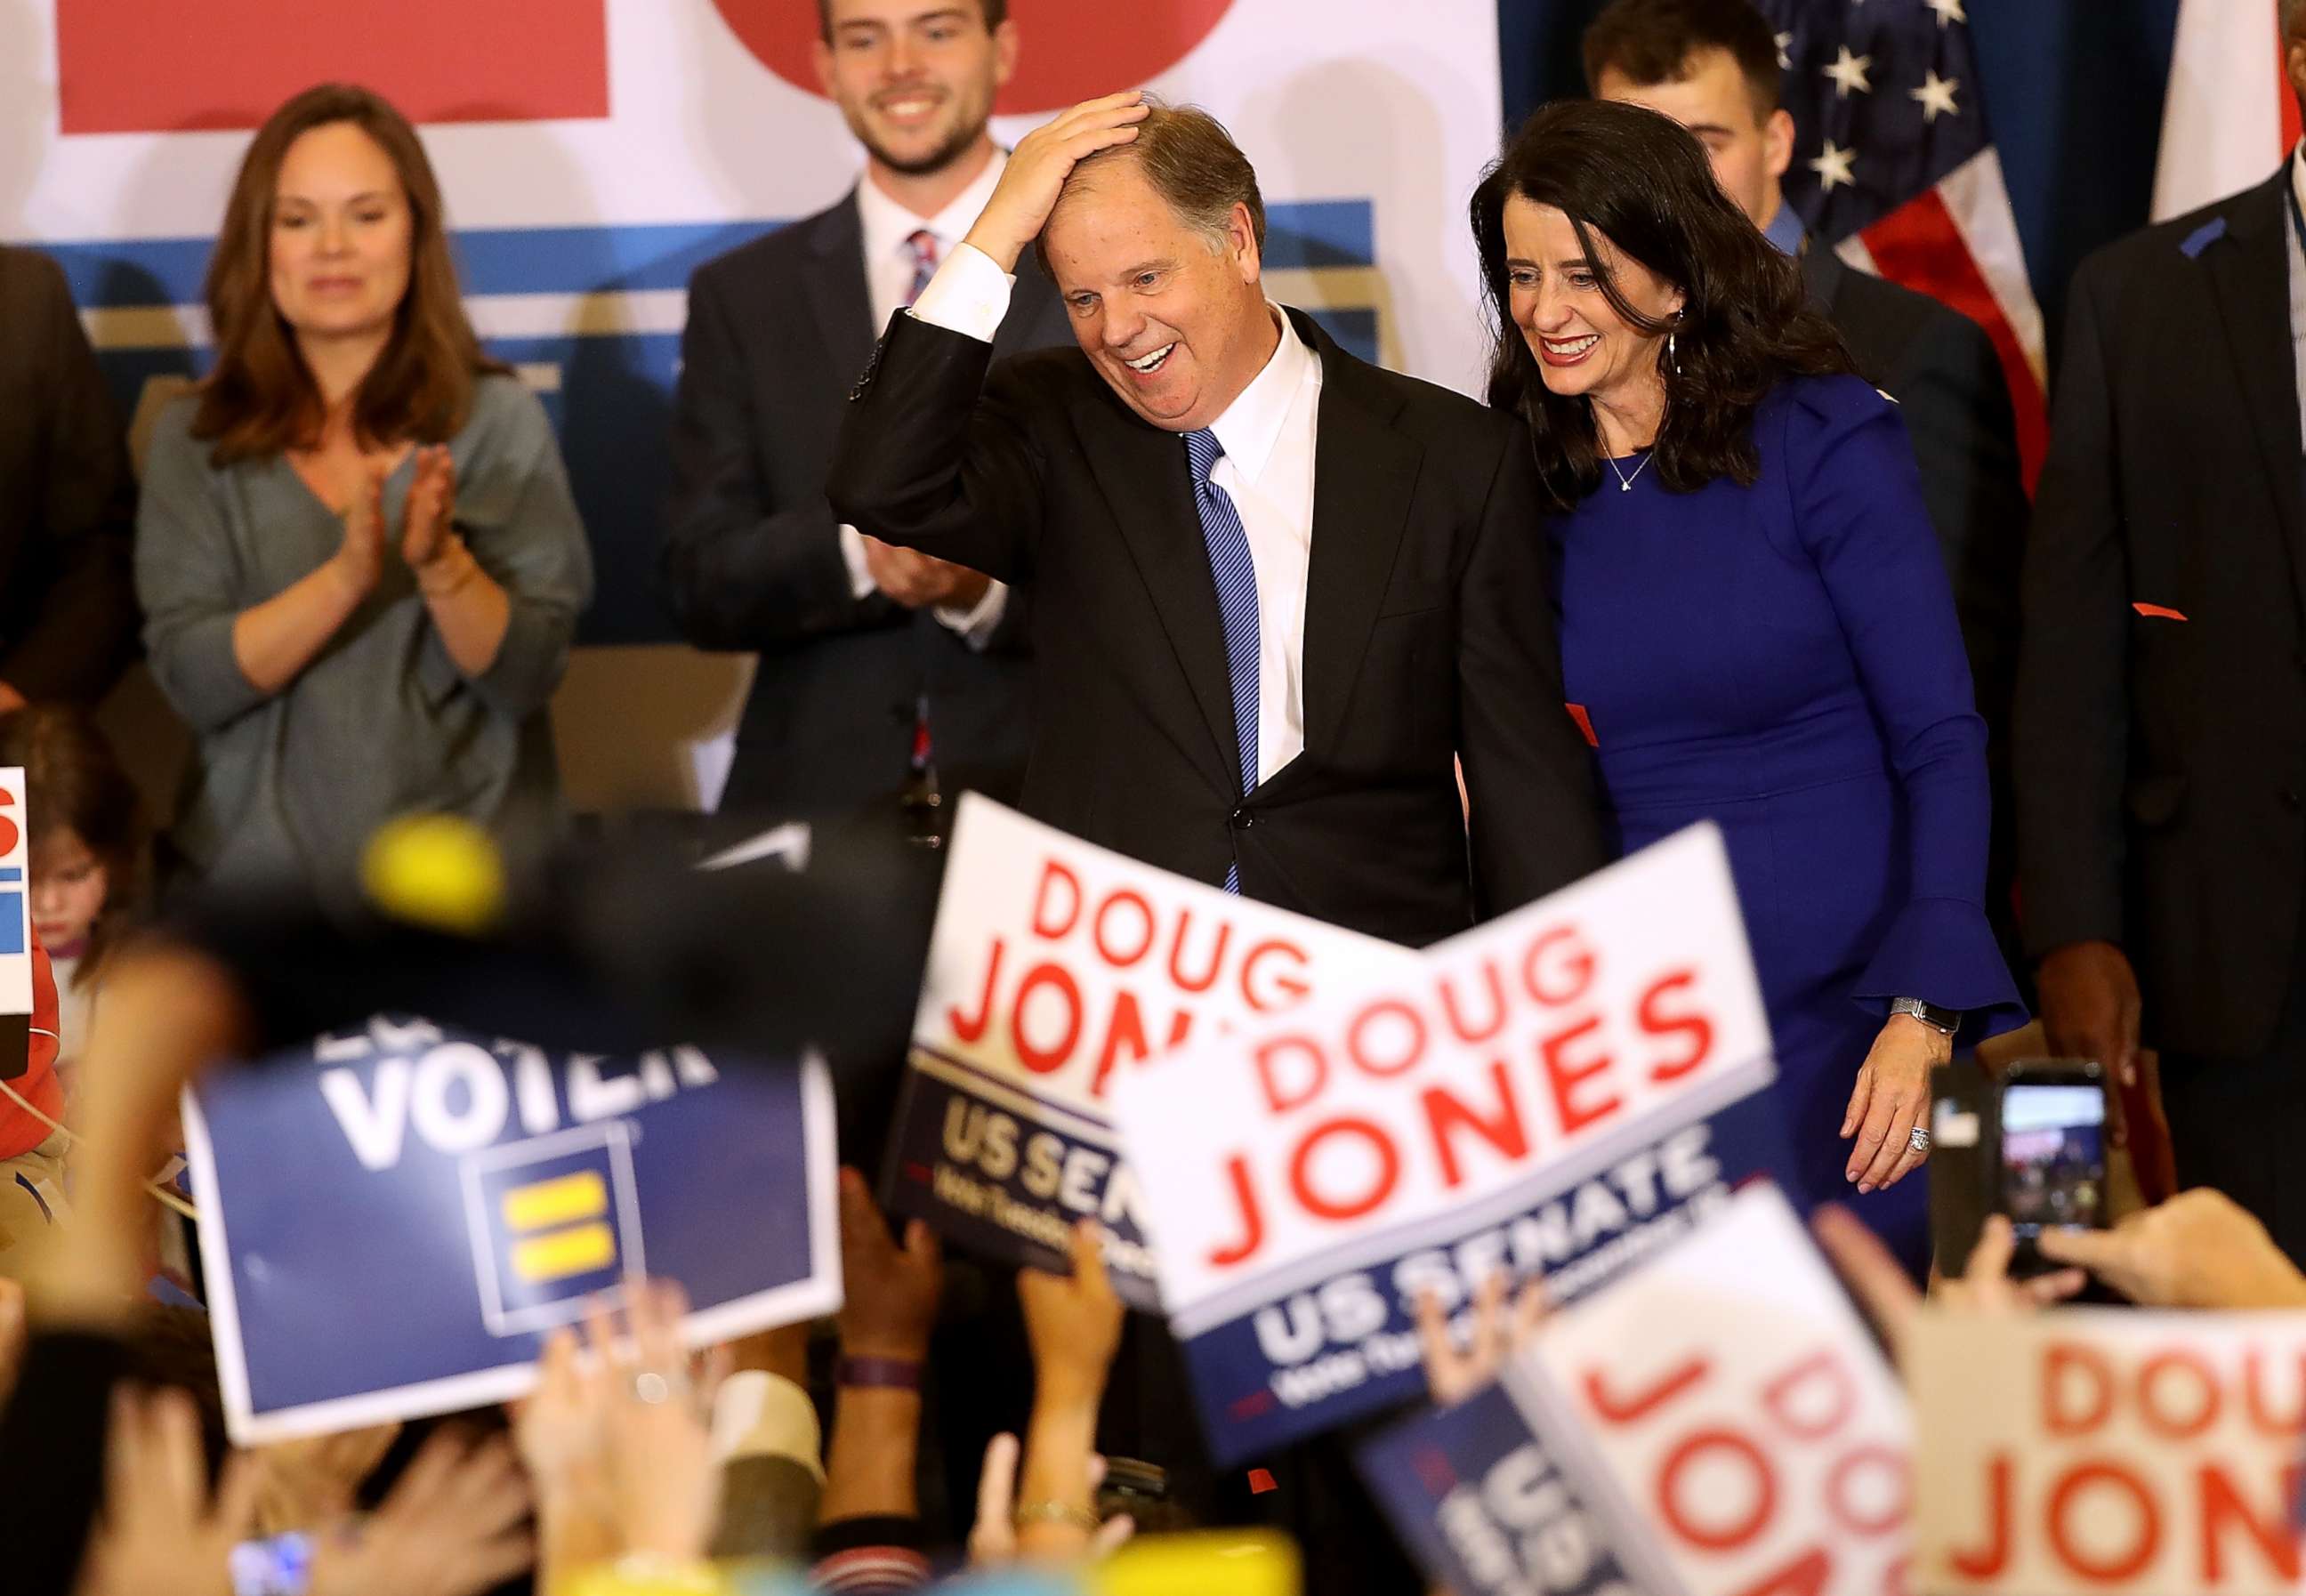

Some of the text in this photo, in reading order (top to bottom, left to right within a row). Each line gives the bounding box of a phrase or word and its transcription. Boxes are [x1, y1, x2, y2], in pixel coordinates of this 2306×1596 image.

[1031, 858, 1313, 1012] DOUG
[946, 936, 1196, 1099] JON
[1253, 922, 1598, 1114] DOUG
[941, 1094, 1023, 1181] US
[1207, 966, 1715, 1268] JONES
[1253, 1270, 1390, 1366] US
[1393, 1121, 1721, 1312] SENATE
[1947, 1445, 2306, 1585] JON
